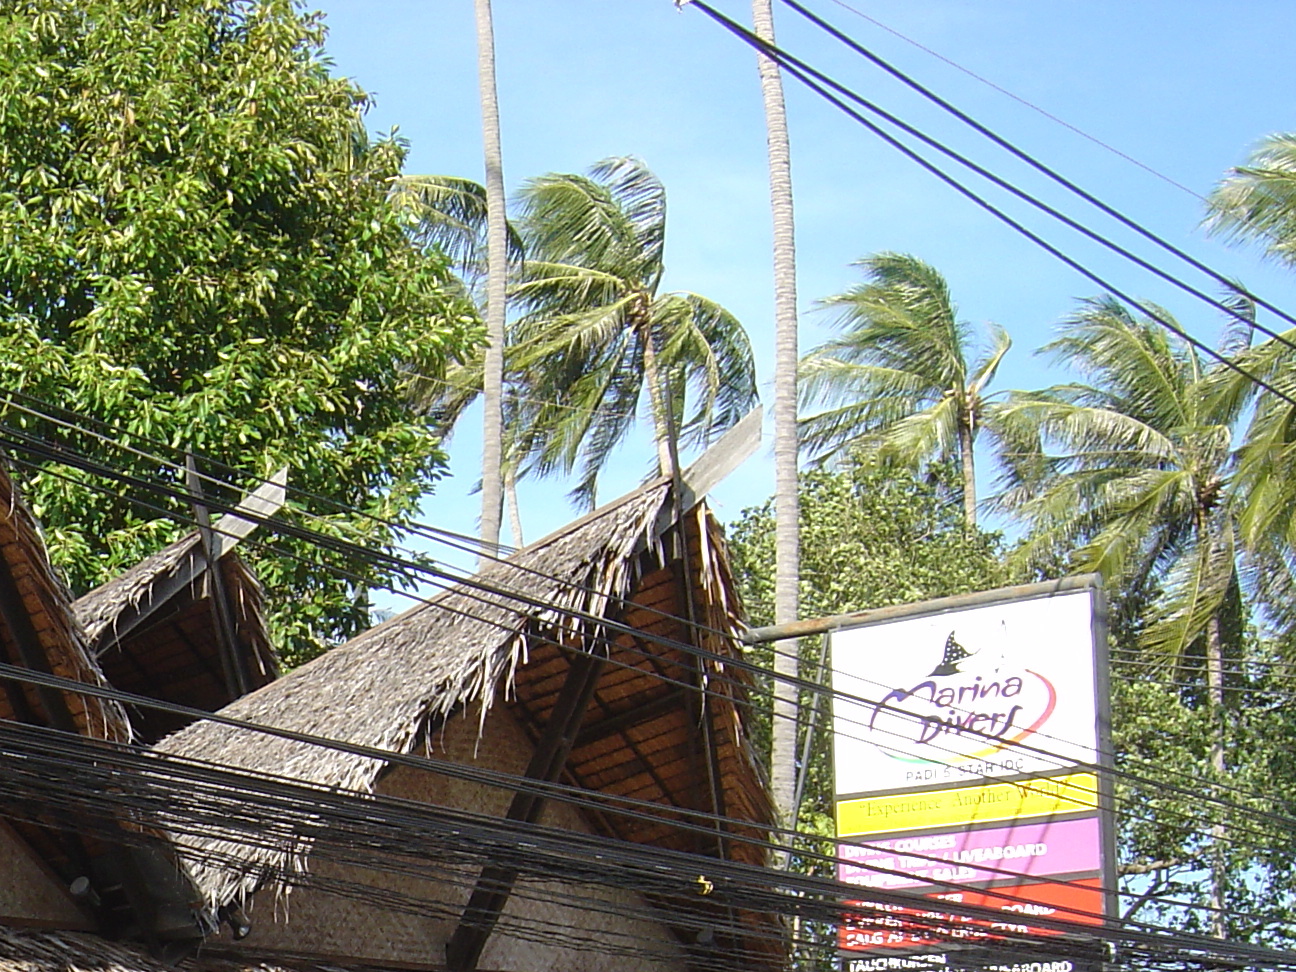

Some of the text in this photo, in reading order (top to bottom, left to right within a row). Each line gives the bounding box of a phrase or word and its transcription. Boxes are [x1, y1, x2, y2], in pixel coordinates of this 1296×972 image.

[869, 676, 1023, 732] Marina
[915, 705, 1023, 744] Divers
[906, 769, 937, 781] PADI
[952, 788, 1011, 807] Another
[893, 834, 956, 853] COURSES
[952, 842, 1048, 865] LIVEABOARD
[932, 866, 977, 881] SALES
